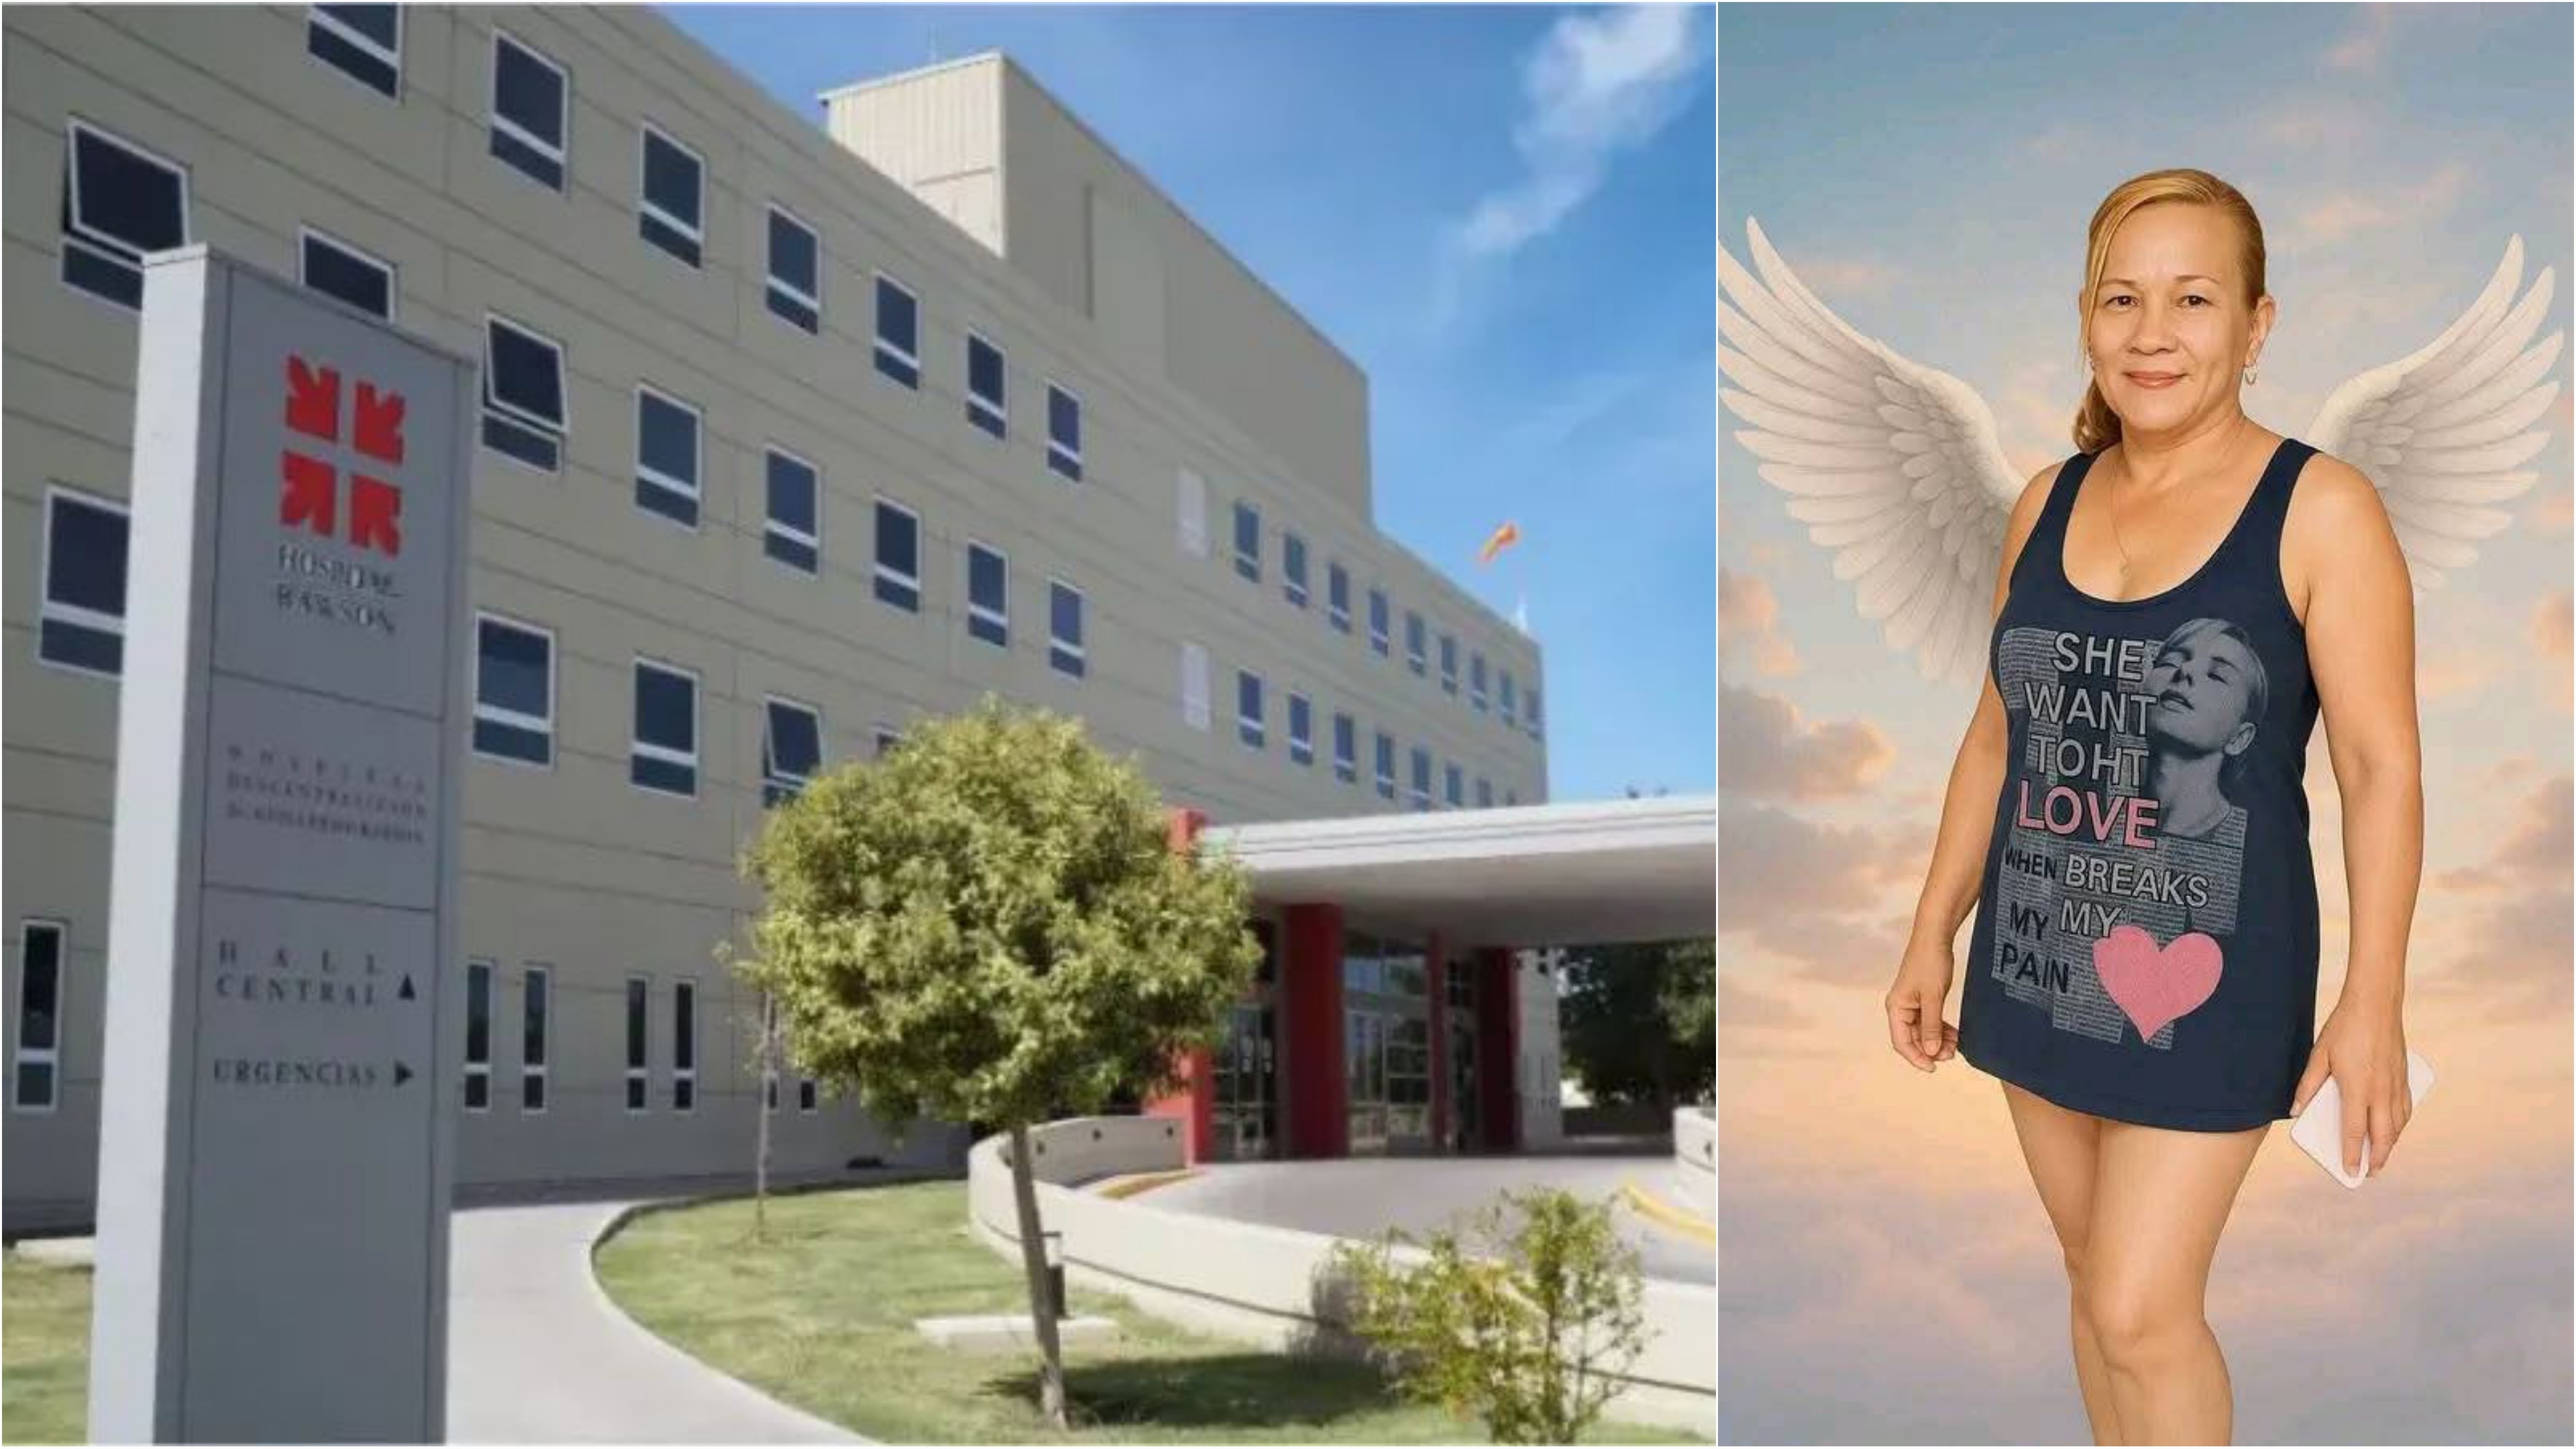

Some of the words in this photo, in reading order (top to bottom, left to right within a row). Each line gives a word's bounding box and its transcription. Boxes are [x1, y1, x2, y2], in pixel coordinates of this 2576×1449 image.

[2051, 632, 2145, 681] SHE
[2024, 682, 2157, 735] WANT
[2017, 780, 2159, 849] LOVE
[2004, 846, 2057, 879] WHEN
[2063, 853, 2210, 908] BREAKS
[2010, 901, 2049, 940] MY
[2058, 899, 2123, 937] MY
[2000, 943, 2070, 994] PAIN
